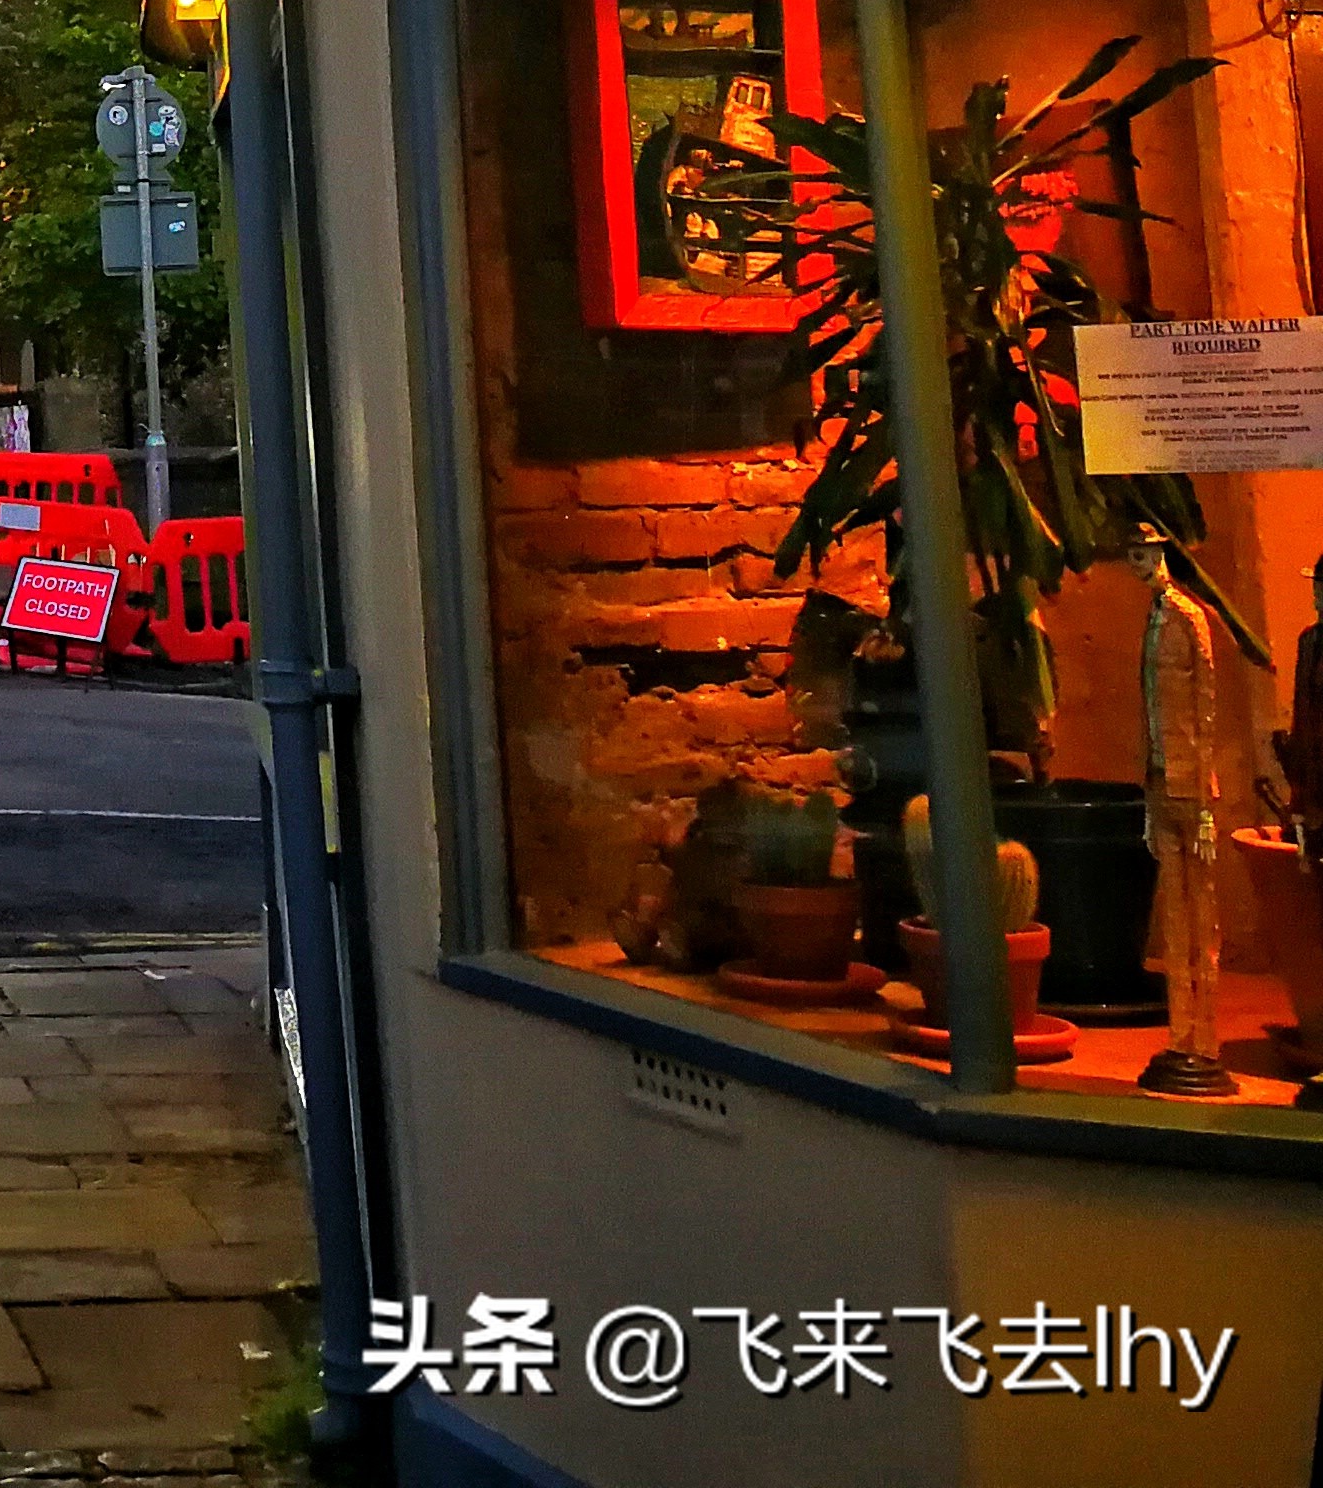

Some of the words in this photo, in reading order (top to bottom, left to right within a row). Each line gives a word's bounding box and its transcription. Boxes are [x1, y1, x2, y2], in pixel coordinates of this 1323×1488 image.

[1228, 316, 1301, 333] WAITER
[1172, 338, 1261, 355] REQUIRED
[22, 573, 107, 598] FOOTPATH
[25, 598, 91, 620] CLOSED
